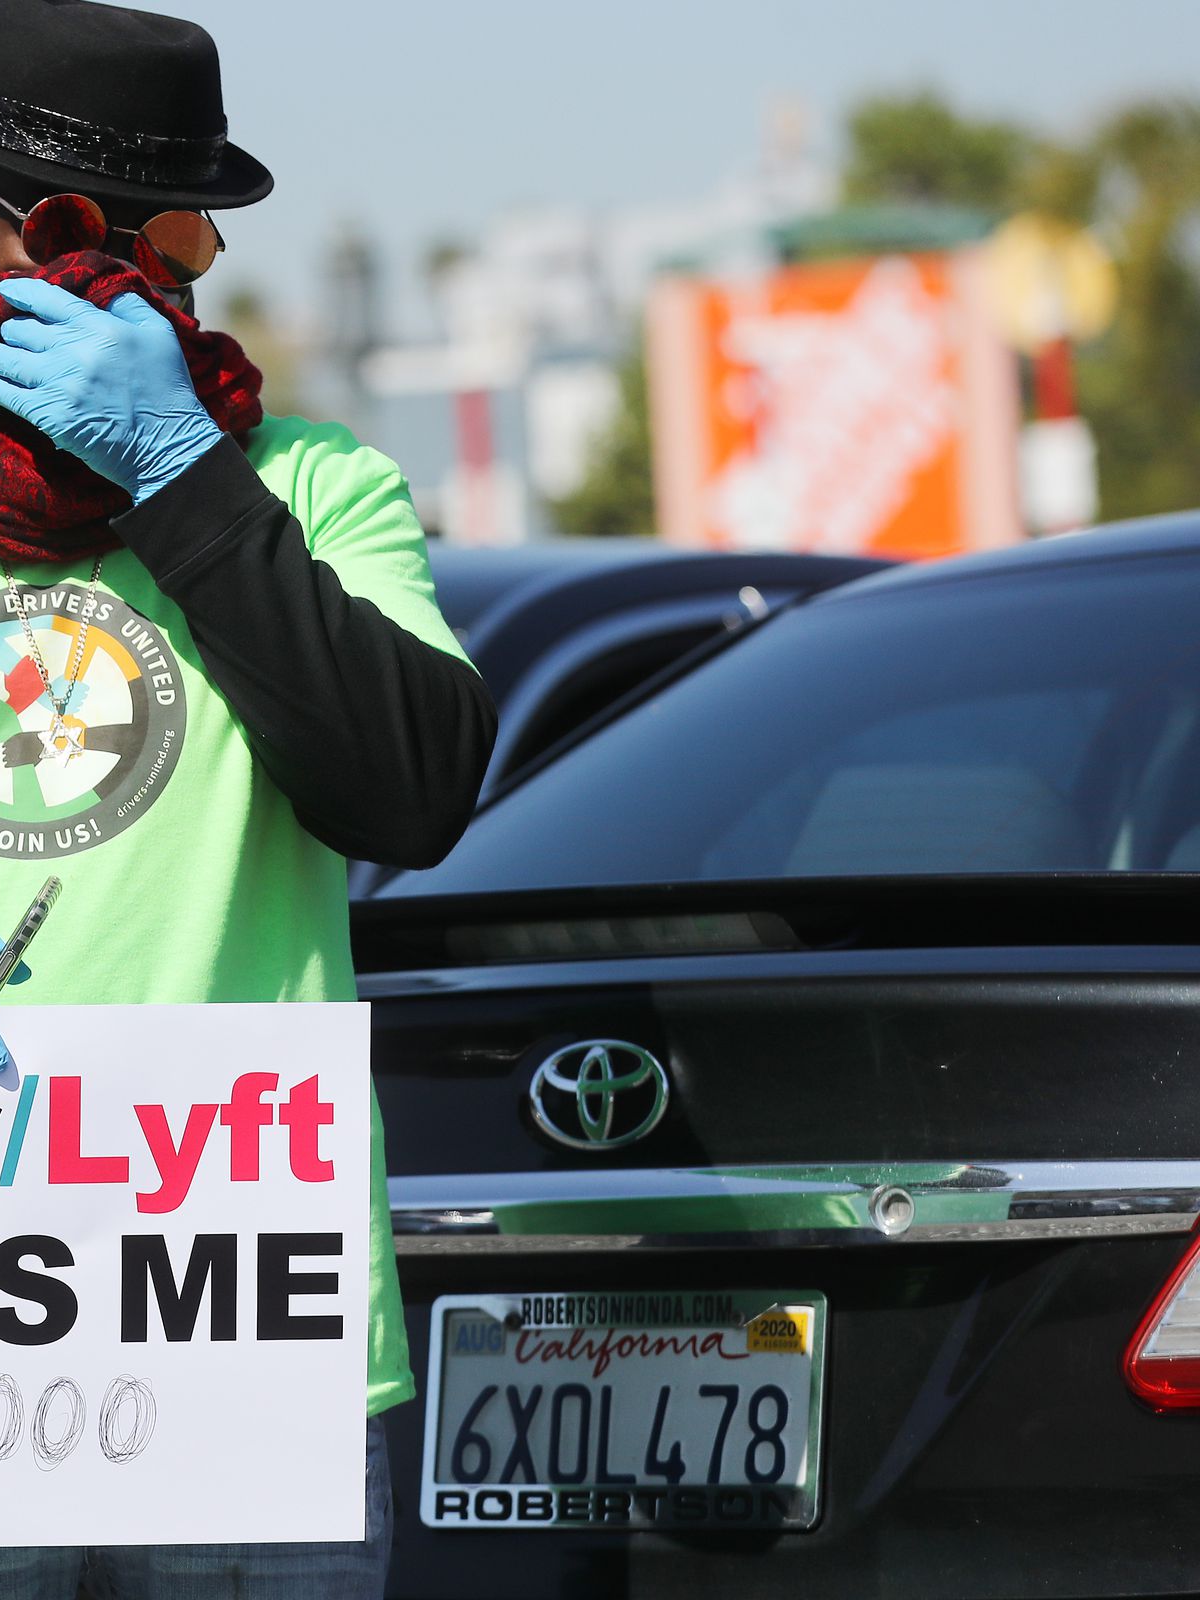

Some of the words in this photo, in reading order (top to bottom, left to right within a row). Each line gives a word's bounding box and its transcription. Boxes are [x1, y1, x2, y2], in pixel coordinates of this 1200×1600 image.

[3, 591, 114, 622] DRIVERS
[120, 619, 176, 706] UNITED
[116, 729, 175, 818] drivers-united.org
[55, 818, 103, 847] US!
[120, 1232, 344, 1343] ME
[520, 1296, 733, 1326] ROBERTSONHONDA.COM
[455, 1323, 501, 1350] AUG
[759, 1319, 797, 1337] 2020
[515, 1327, 750, 1379] California
[435, 1490, 800, 1521] ROBERTSON
